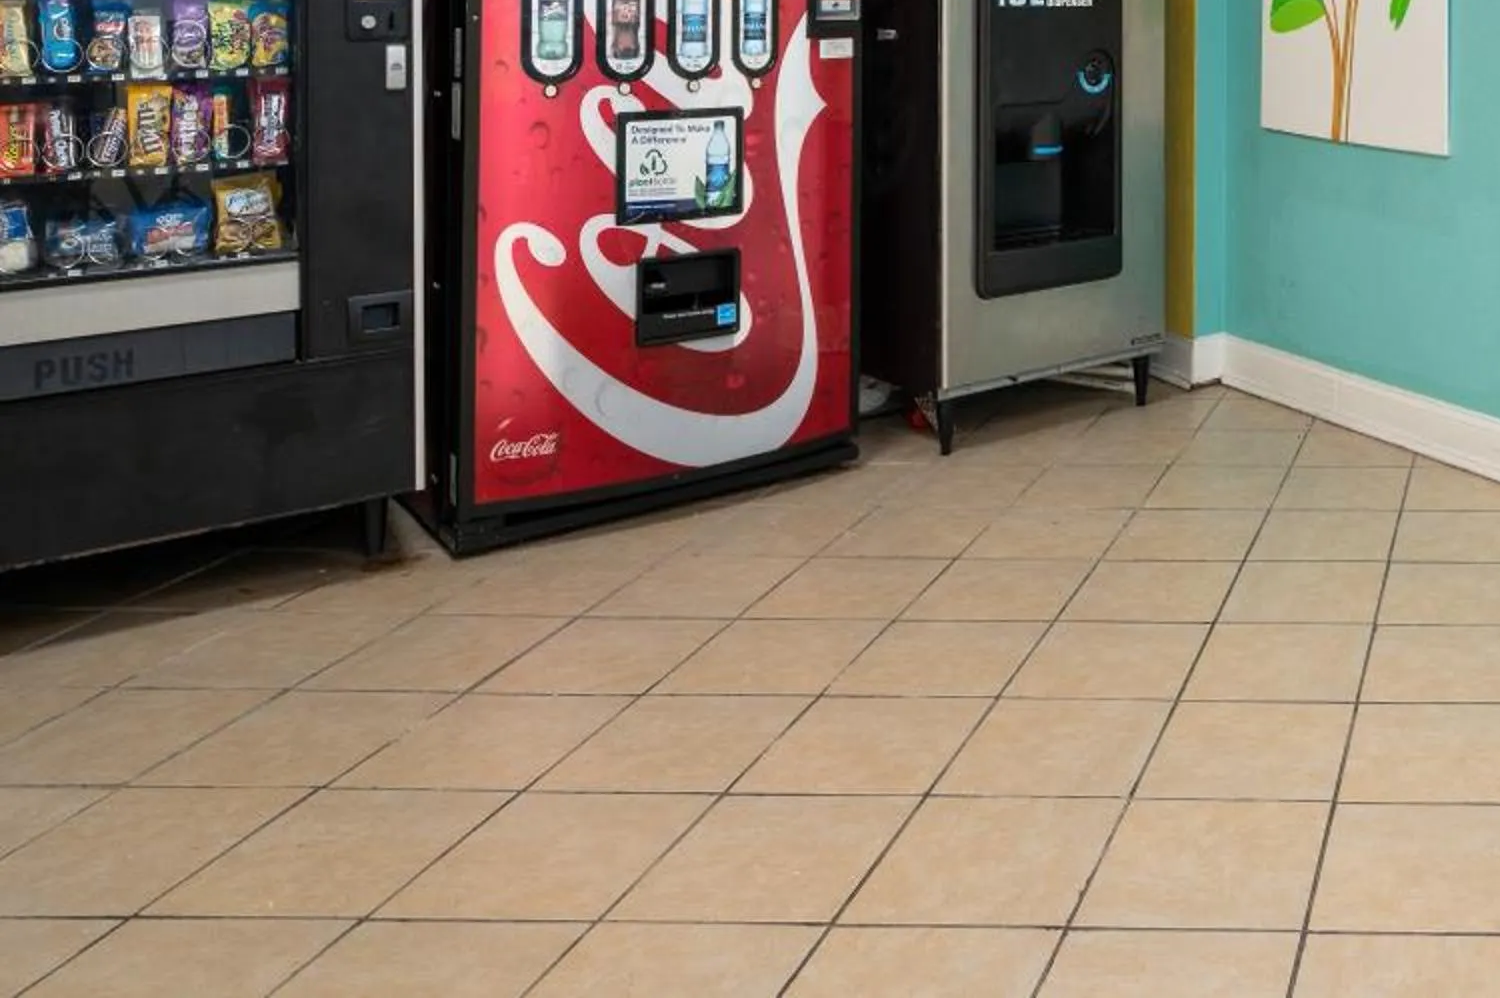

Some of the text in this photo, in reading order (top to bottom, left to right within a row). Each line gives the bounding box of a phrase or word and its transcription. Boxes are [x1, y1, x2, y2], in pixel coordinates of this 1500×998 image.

[631, 125, 673, 135] Designed
[631, 136, 638, 145] A
[34, 347, 135, 391] PUSH
[489, 432, 558, 462] Coca-Cola
